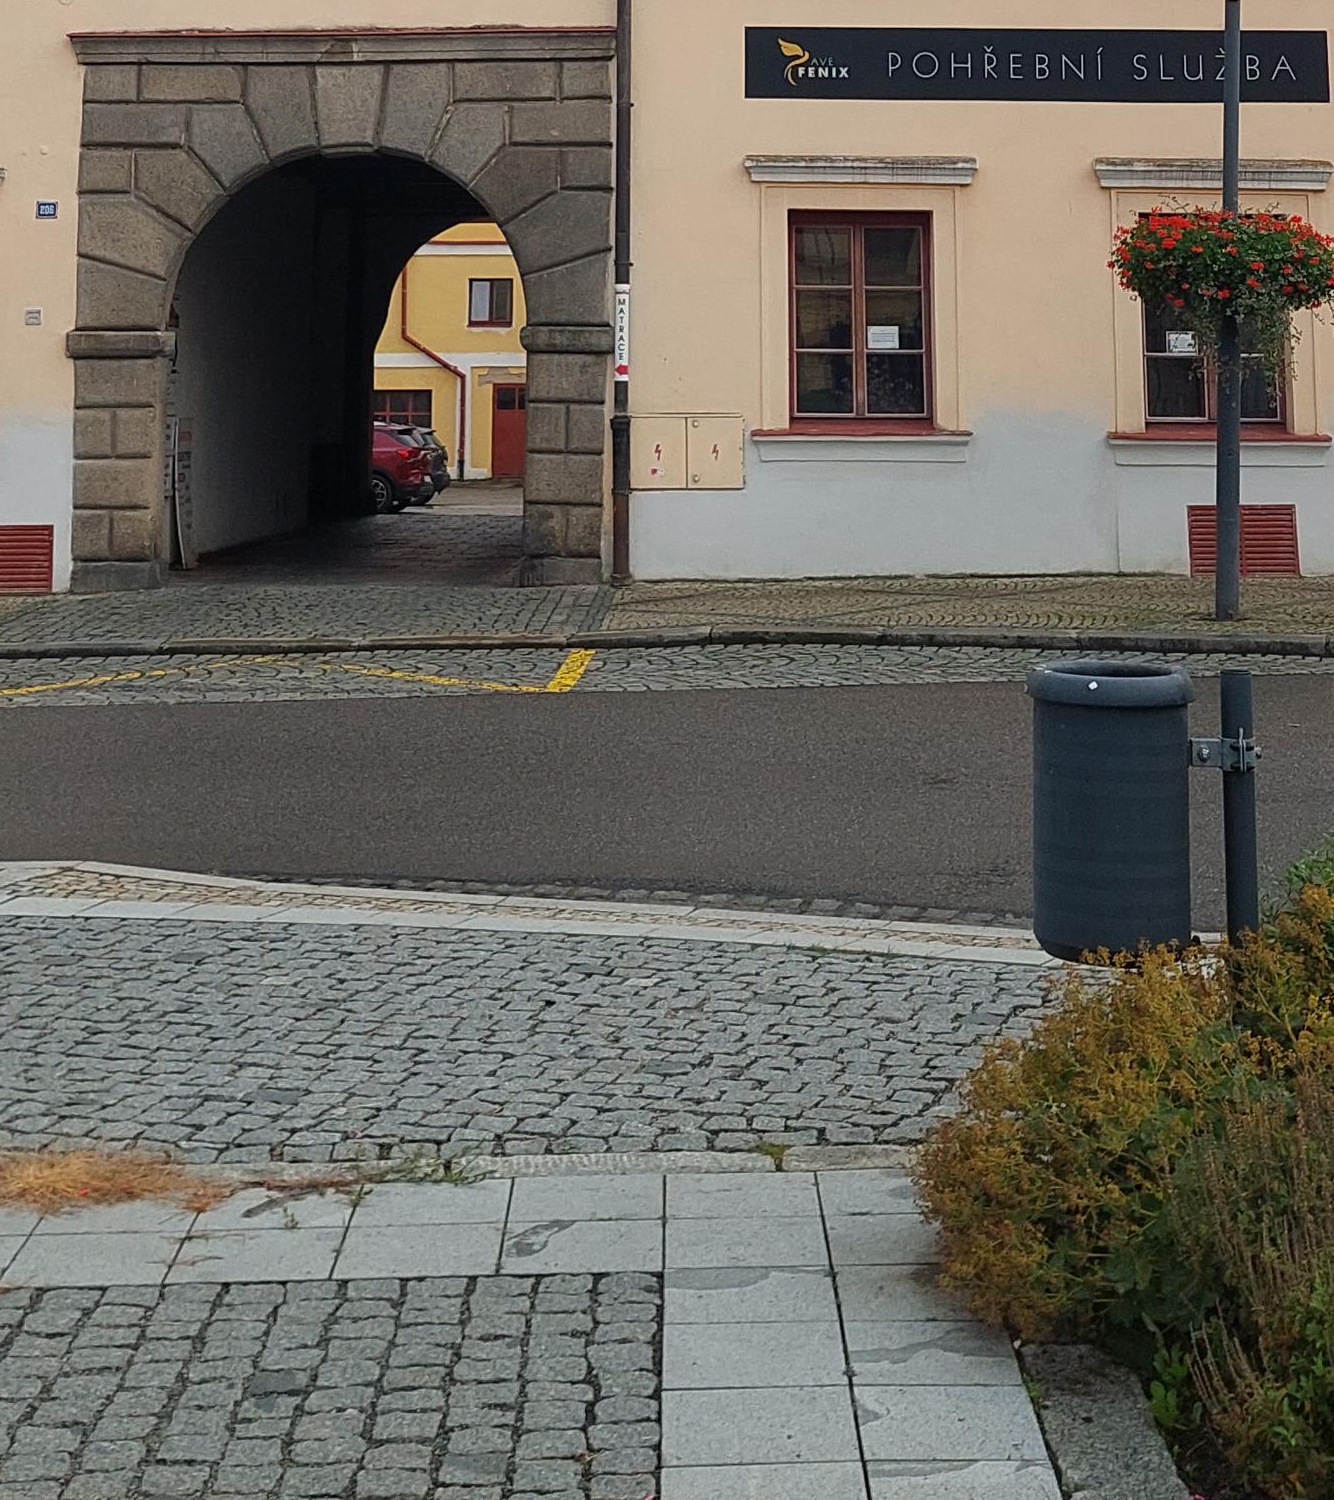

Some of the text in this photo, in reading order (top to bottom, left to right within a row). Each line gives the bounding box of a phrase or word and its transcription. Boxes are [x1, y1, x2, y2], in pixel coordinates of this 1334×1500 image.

[798, 67, 849, 78] FENIX
[811, 57, 834, 66] AVE
[888, 45, 1104, 80] POHŘEBNÍ
[617, 298, 626, 361] MATRACE
